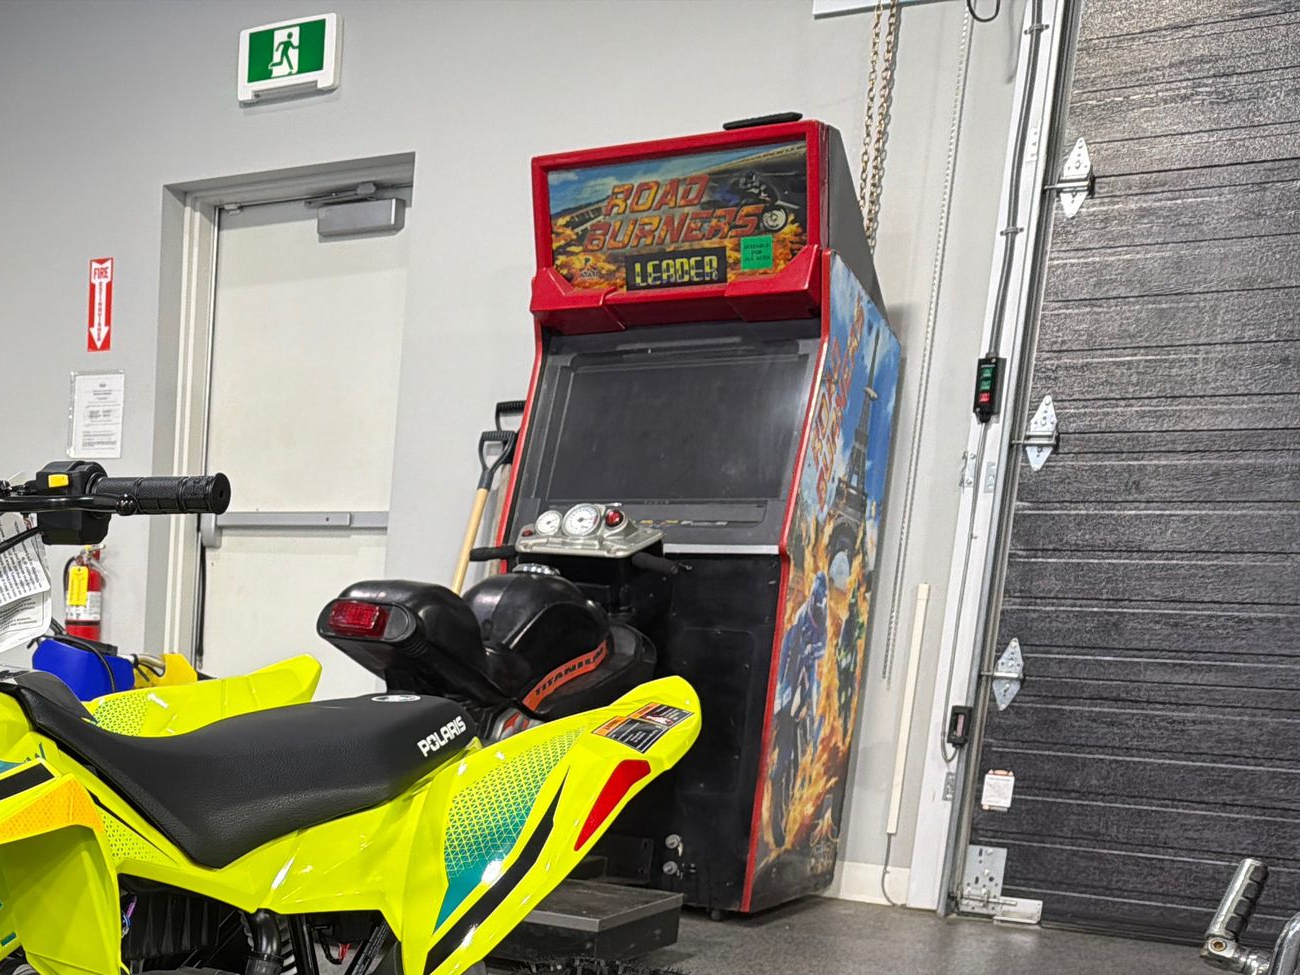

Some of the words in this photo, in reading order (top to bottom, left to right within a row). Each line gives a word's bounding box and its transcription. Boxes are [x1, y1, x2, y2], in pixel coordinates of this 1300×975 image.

[603, 174, 710, 217] ROAD
[583, 204, 766, 252] BURNERS
[93, 266, 109, 280] FIRE
[634, 256, 718, 286] LEADER
[417, 715, 467, 757] POLARIS
